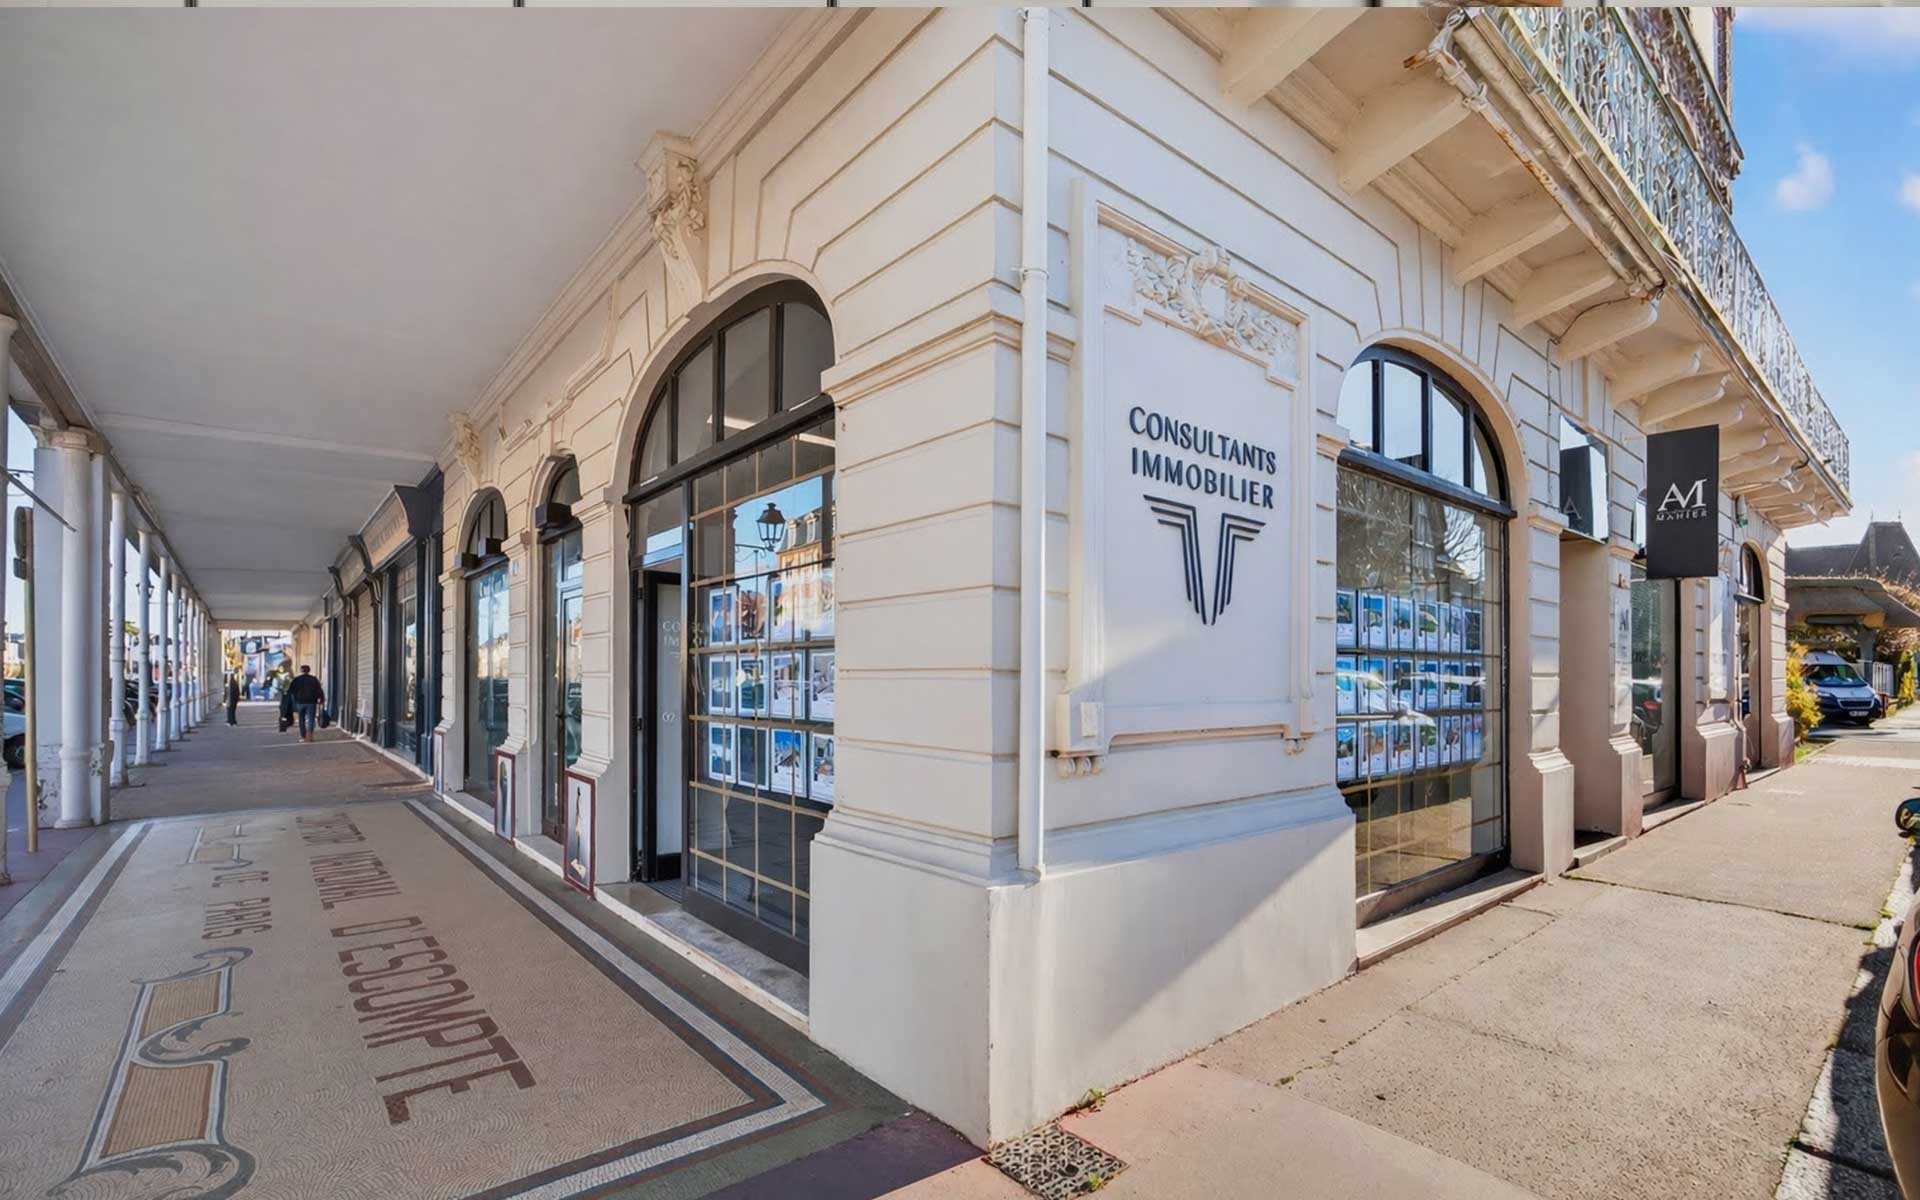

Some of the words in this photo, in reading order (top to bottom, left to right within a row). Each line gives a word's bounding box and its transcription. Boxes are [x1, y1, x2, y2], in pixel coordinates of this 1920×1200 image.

[1129, 406, 1276, 475] CONSULTANTS
[1132, 447, 1274, 509] IMMOBILIER
[202, 897, 272, 940] PARIS
[330, 916, 536, 1124] D'ESCOMPTE
